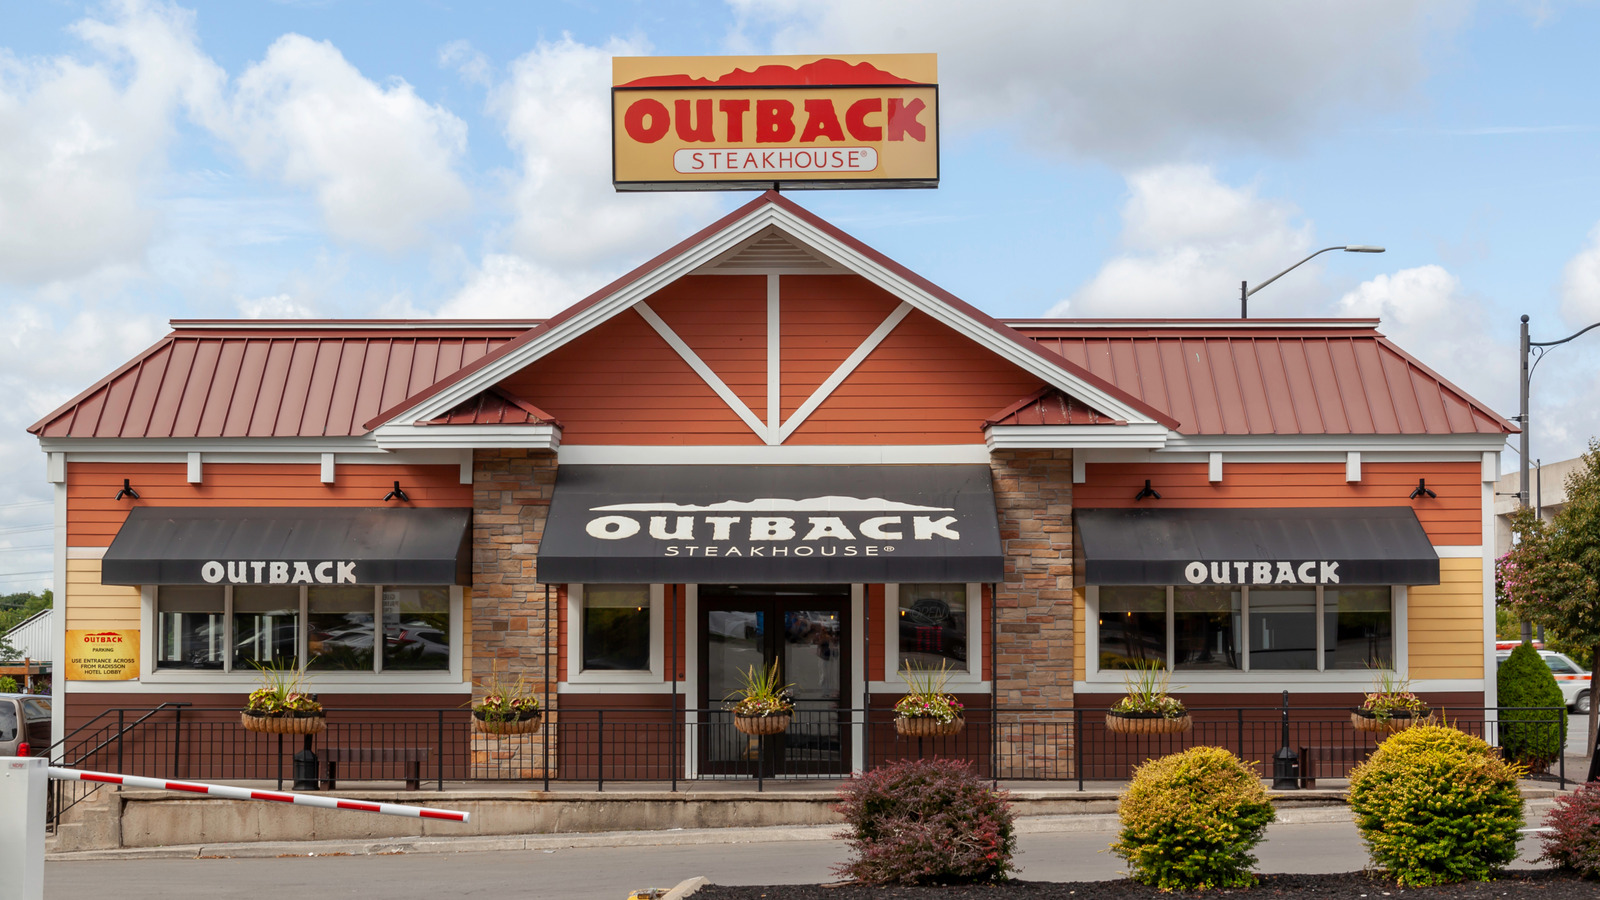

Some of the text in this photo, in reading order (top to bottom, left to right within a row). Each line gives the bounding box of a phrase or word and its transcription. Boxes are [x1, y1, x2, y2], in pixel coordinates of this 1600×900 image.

[624, 97, 926, 144] OUTBACK
[585, 515, 960, 541] OUTBACK
[201, 560, 357, 584] OUTBACK
[1184, 561, 1340, 584] OUTBACK
